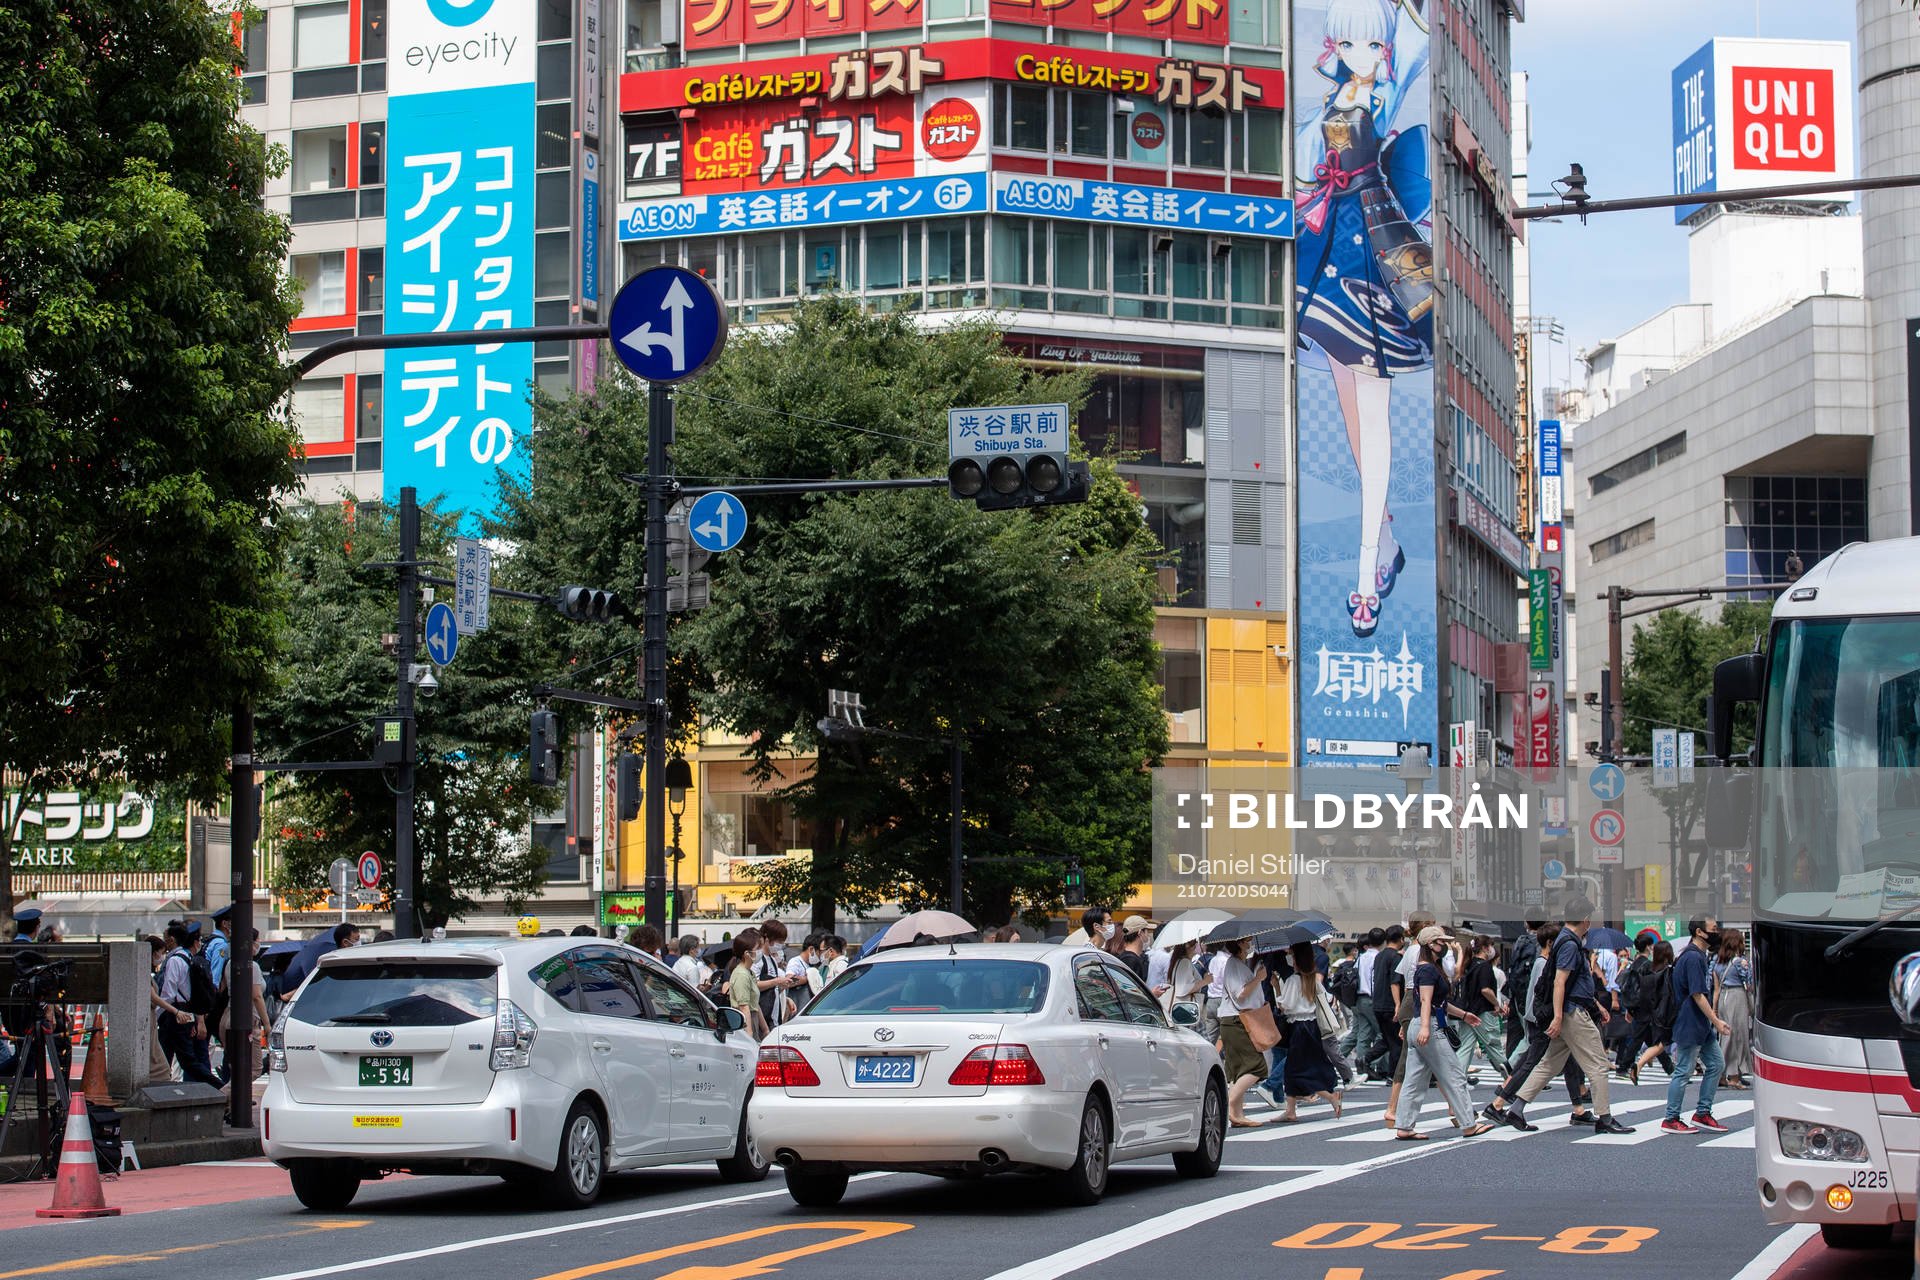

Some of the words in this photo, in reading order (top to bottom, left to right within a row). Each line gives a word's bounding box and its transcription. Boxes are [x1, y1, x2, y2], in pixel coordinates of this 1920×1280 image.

[405, 32, 517, 74] eyecity
[829, 47, 944, 101] ガスト
[1155, 59, 1263, 112] ガスト
[1682, 69, 1705, 135] THE
[1743, 79, 1815, 117] UNI
[694, 133, 753, 163] Café
[760, 114, 903, 184] ガスト
[929, 125, 975, 145] ガスト
[1136, 127, 1162, 139] ガスト
[1745, 122, 1823, 164] QLO
[629, 140, 681, 178] 7F
[695, 161, 753, 181] レストラン
[1676, 124, 1713, 195] PRIME
[629, 203, 696, 233] AEON
[940, 185, 967, 205] 6F
[1005, 181, 1074, 209] AEON
[402, 151, 462, 468] アイシティ
[470, 146, 514, 465] コンタクトの
[959, 411, 1058, 438] 渋谷駅前
[975, 440, 1020, 452] Shibuya
[1024, 436, 1047, 449] Sta.
[1544, 427, 1557, 444] THE
[464, 547, 475, 627] 渋谷駅前
[1312, 629, 1424, 732] 原神
[1323, 706, 1389, 719] Genshin
[1534, 723, 1548, 762] アコム
[1848, 1170, 1888, 1189] J225
